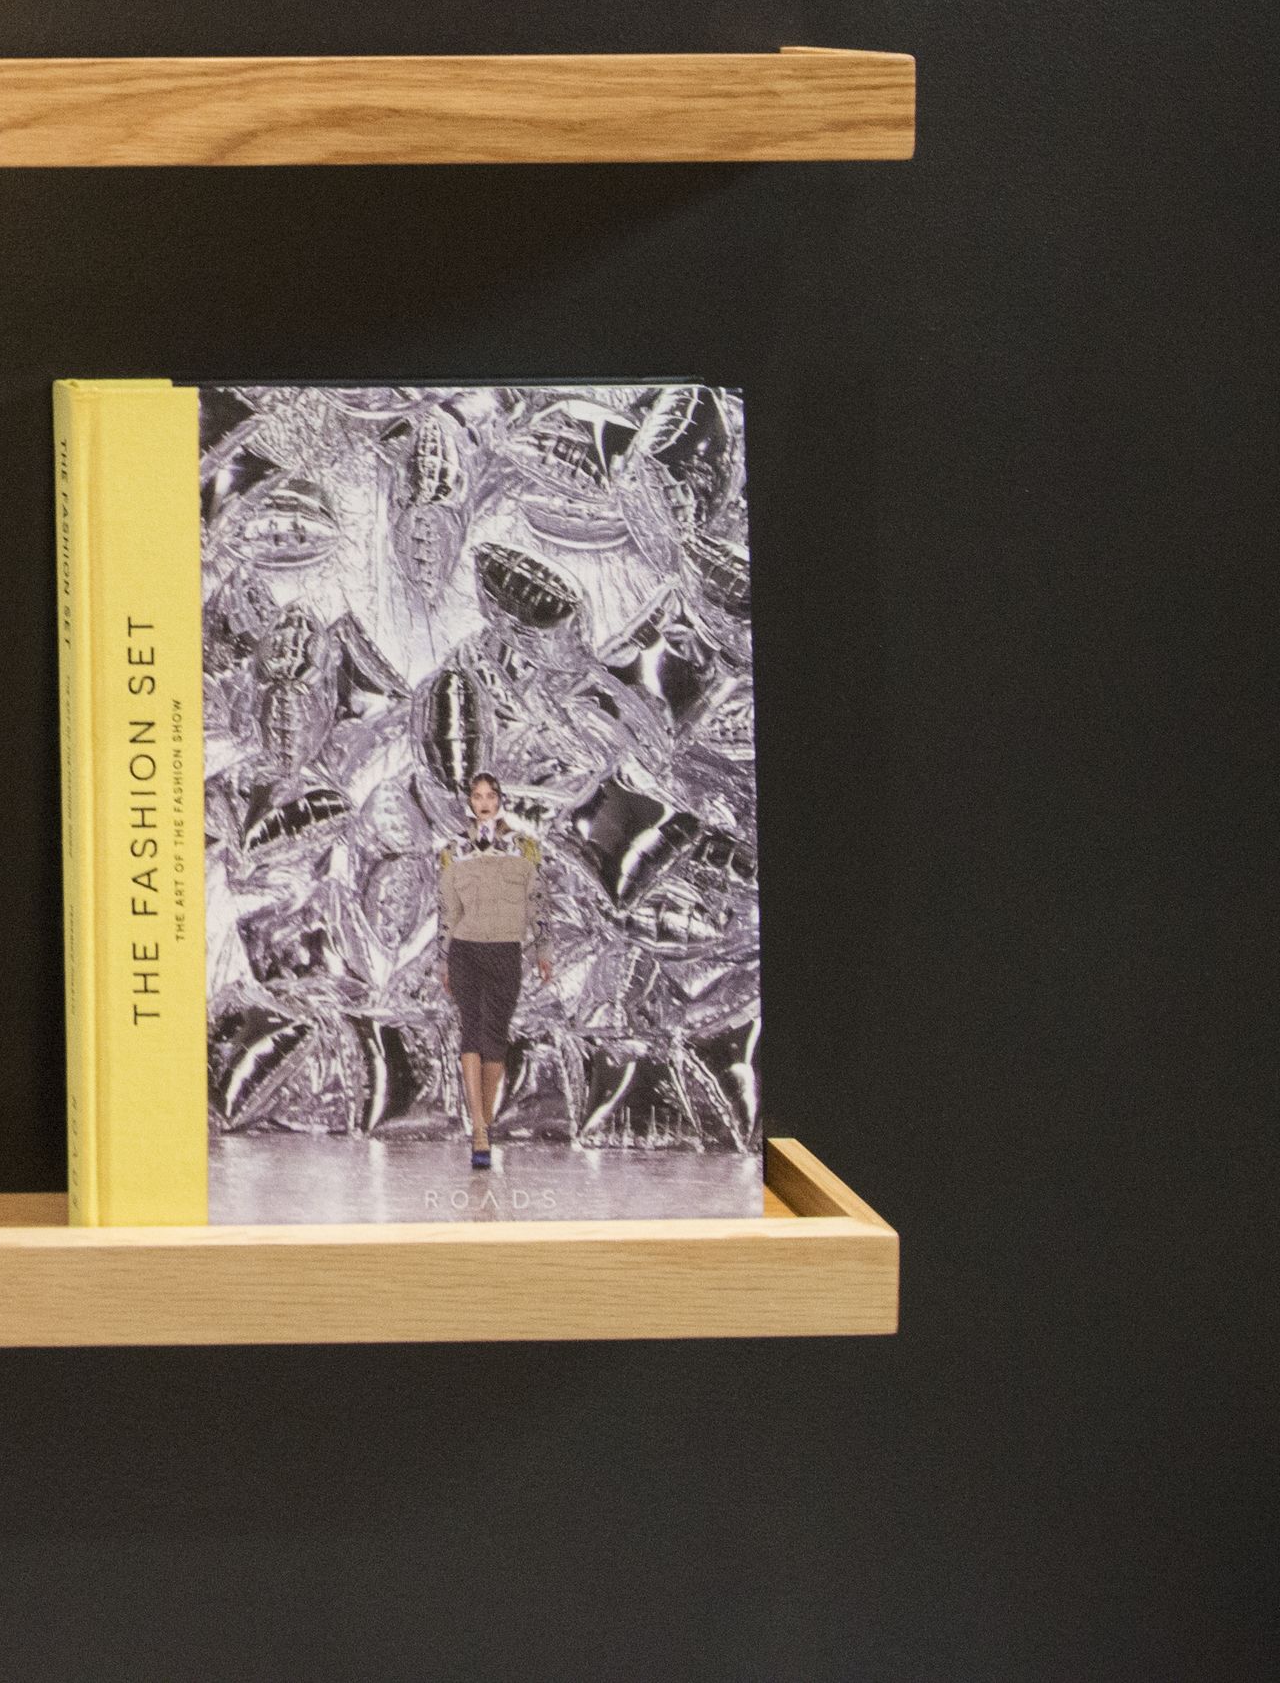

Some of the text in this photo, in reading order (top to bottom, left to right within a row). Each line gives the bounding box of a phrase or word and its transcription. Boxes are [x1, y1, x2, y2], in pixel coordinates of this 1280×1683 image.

[59, 438, 69, 484] THE
[61, 491, 71, 596] FASHION
[127, 616, 160, 1025] THE FASHION SET
[172, 699, 185, 942] THE ART OF THE FASHION SHOW
